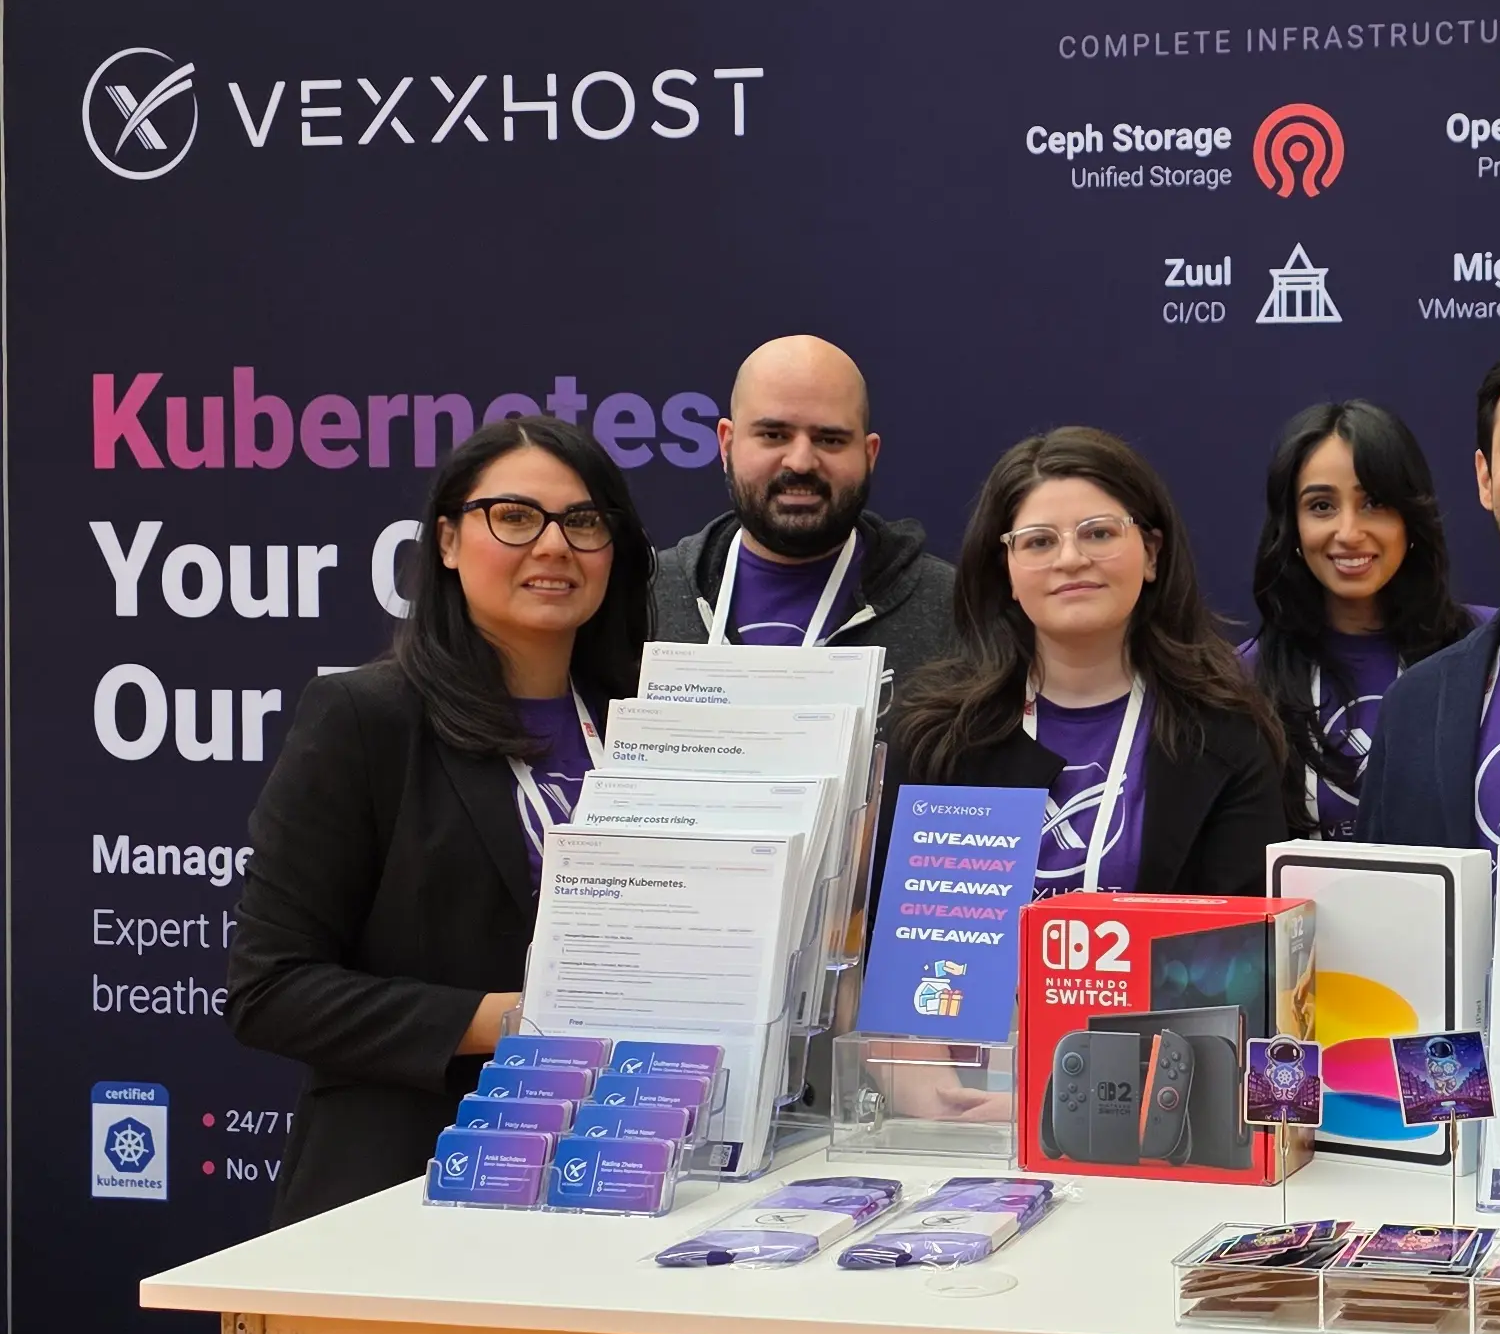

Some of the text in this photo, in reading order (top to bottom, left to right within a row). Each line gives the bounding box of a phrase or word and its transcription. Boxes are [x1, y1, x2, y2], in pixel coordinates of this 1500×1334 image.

[1059, 29, 1231, 59] COMPLETE
[228, 67, 764, 148] VEXXHOST
[1026, 122, 1232, 161] Ceph Storage
[1071, 164, 1232, 190] Unified Storage
[1164, 255, 1232, 287] Zuul
[1162, 301, 1226, 324] CI/CD
[93, 366, 720, 470] Kuberntes
[89, 520, 338, 618] Your
[647, 682, 726, 694] Escape VMware.
[93, 663, 282, 761] Our
[612, 751, 637, 761] Gate
[613, 740, 746, 755] Stop merging broken code.
[586, 812, 698, 826] Hyperscaler costs rising.
[930, 804, 992, 817] VEXXHOST
[912, 831, 1021, 849] GIVEAWAY
[908, 855, 1017, 873] GIVEAWAY
[555, 874, 687, 888] Stop managing Kubernetes.
[904, 878, 1013, 897] GIVEAWAY
[554, 886, 623, 899] Start shipping.
[900, 903, 1009, 921] GIVEAWAY
[92, 908, 210, 956] Expert
[895, 927, 1005, 945] GIVEAWAY
[1094, 920, 1131, 972] 2
[1045, 977, 1128, 990] NINTENDO
[1045, 988, 1127, 1007] SWITCH
[568, 1018, 584, 1026] Free
[104, 1087, 155, 1102] certified
[225, 1110, 279, 1135] 24/7
[226, 1158, 258, 1182] No
[96, 1175, 163, 1190] kubernetes
